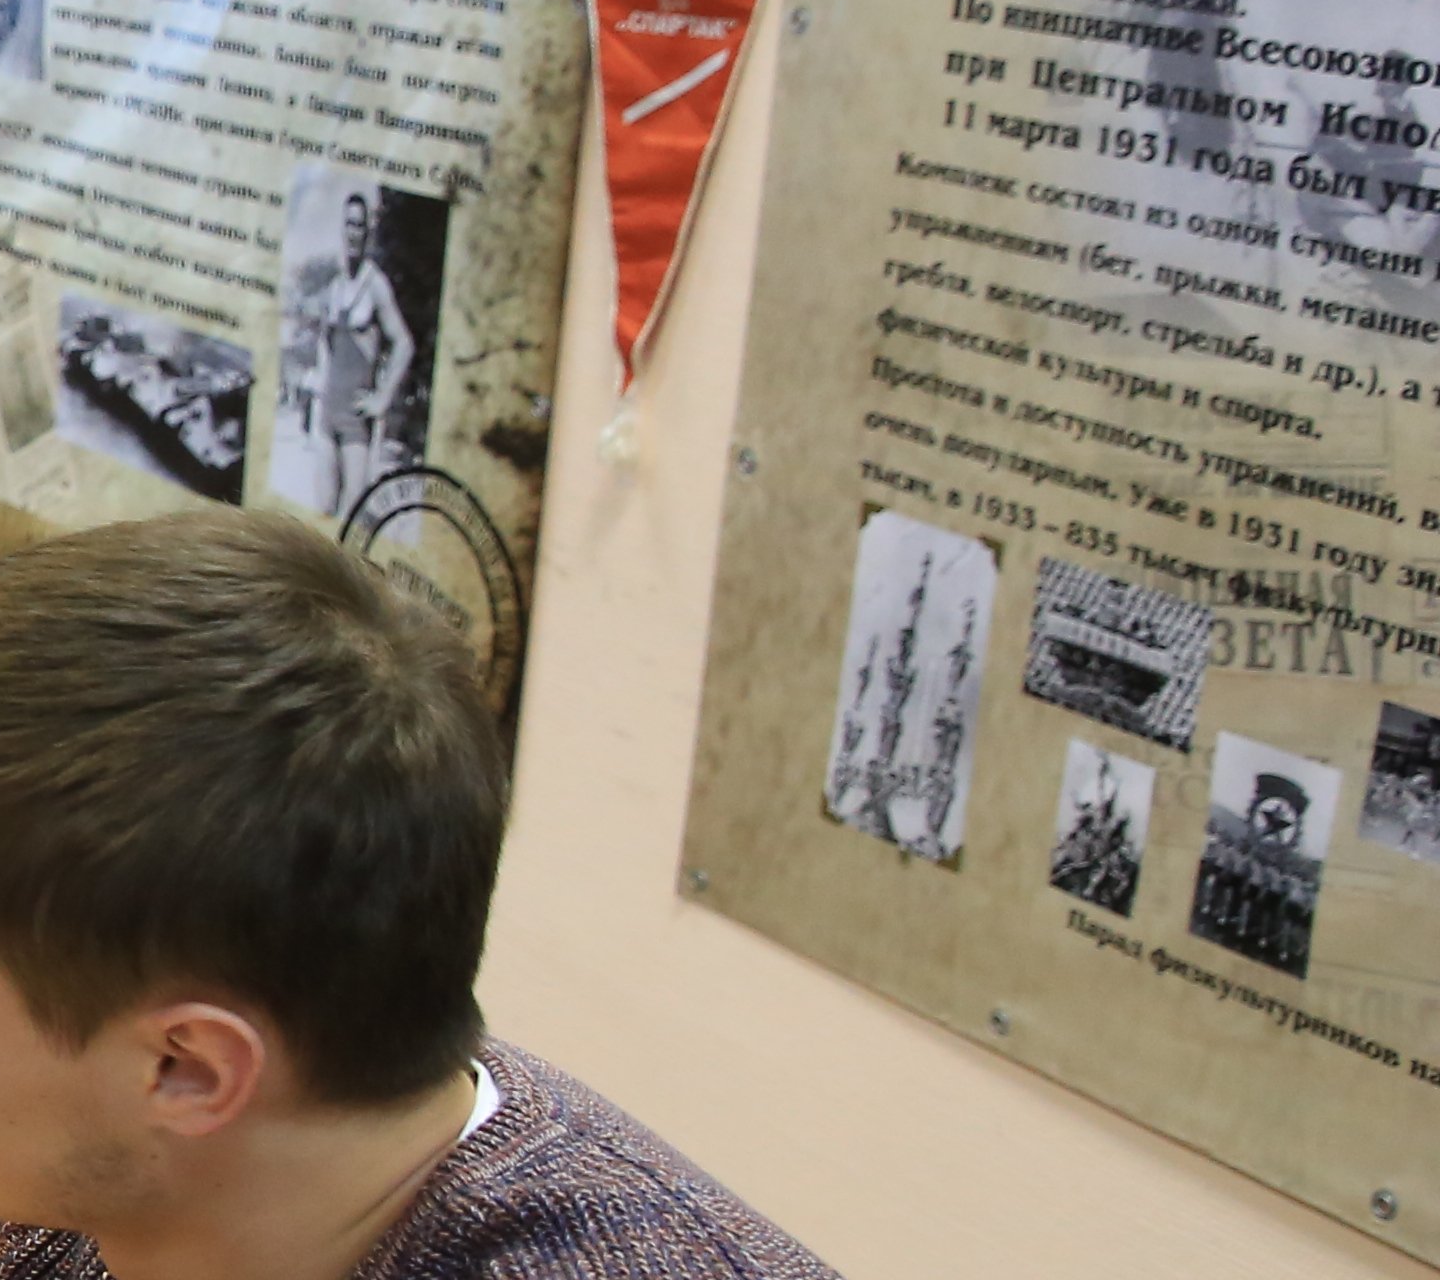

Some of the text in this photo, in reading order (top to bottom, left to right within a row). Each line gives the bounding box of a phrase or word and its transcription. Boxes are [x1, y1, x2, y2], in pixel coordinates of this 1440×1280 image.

[1002, 6, 1205, 54] инициативе
[943, 52, 1007, 85] при
[1031, 58, 1288, 127] Центральном
[943, 99, 975, 128] 11
[987, 115, 1080, 150] марта
[1098, 124, 1177, 166] 1931
[1193, 149, 1275, 184] года
[1287, 155, 1366, 202] был
[894, 152, 1424, 278] Комплекс состоял из одной ступени
[1155, 262, 1288, 314] прыжки,
[876, 306, 1323, 442] физической культуры и спорта.
[1141, 317, 1275, 369] стрельба
[1283, 352, 1305, 375] и
[1401, 381, 1421, 404] а
[992, 393, 1009, 416] и
[1014, 395, 1189, 465] доступность
[1198, 448, 1407, 525] упражнений,
[945, 487, 962, 510] в
[973, 489, 1036, 533] 1933
[1065, 522, 1118, 558] 835
[1127, 543, 1221, 588] тысяч
[1129, 479, 1189, 521] Уже
[1197, 507, 1216, 529] в
[1229, 511, 1300, 554] 1931
[1313, 541, 1387, 585] году
[1210, 619, 1353, 675] ЗЕТА
[1149, 946, 1401, 1068] физкультурников
